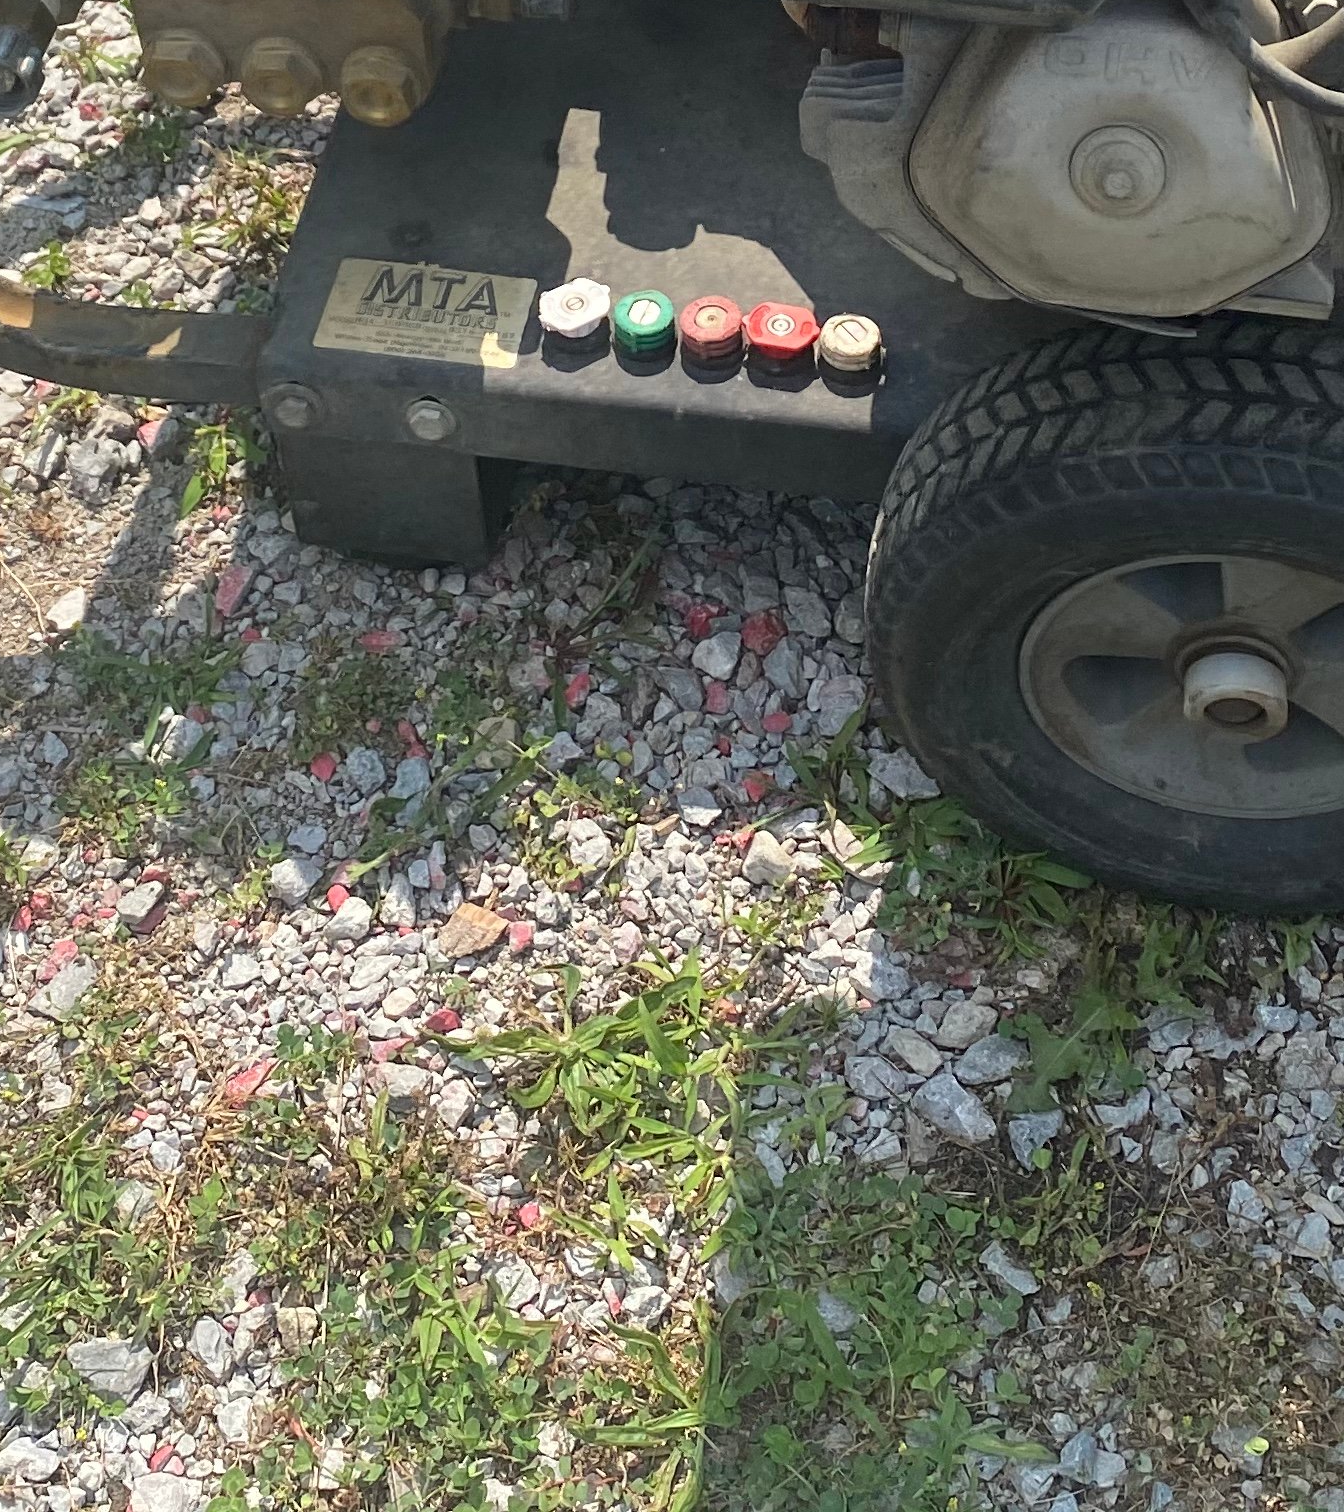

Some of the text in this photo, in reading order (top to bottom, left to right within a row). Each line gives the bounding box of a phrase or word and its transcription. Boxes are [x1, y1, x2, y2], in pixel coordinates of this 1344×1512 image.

[1043, 35, 1216, 90] OHV
[356, 302, 498, 330] DISTRIBUTORS
[360, 264, 498, 317] MTA
